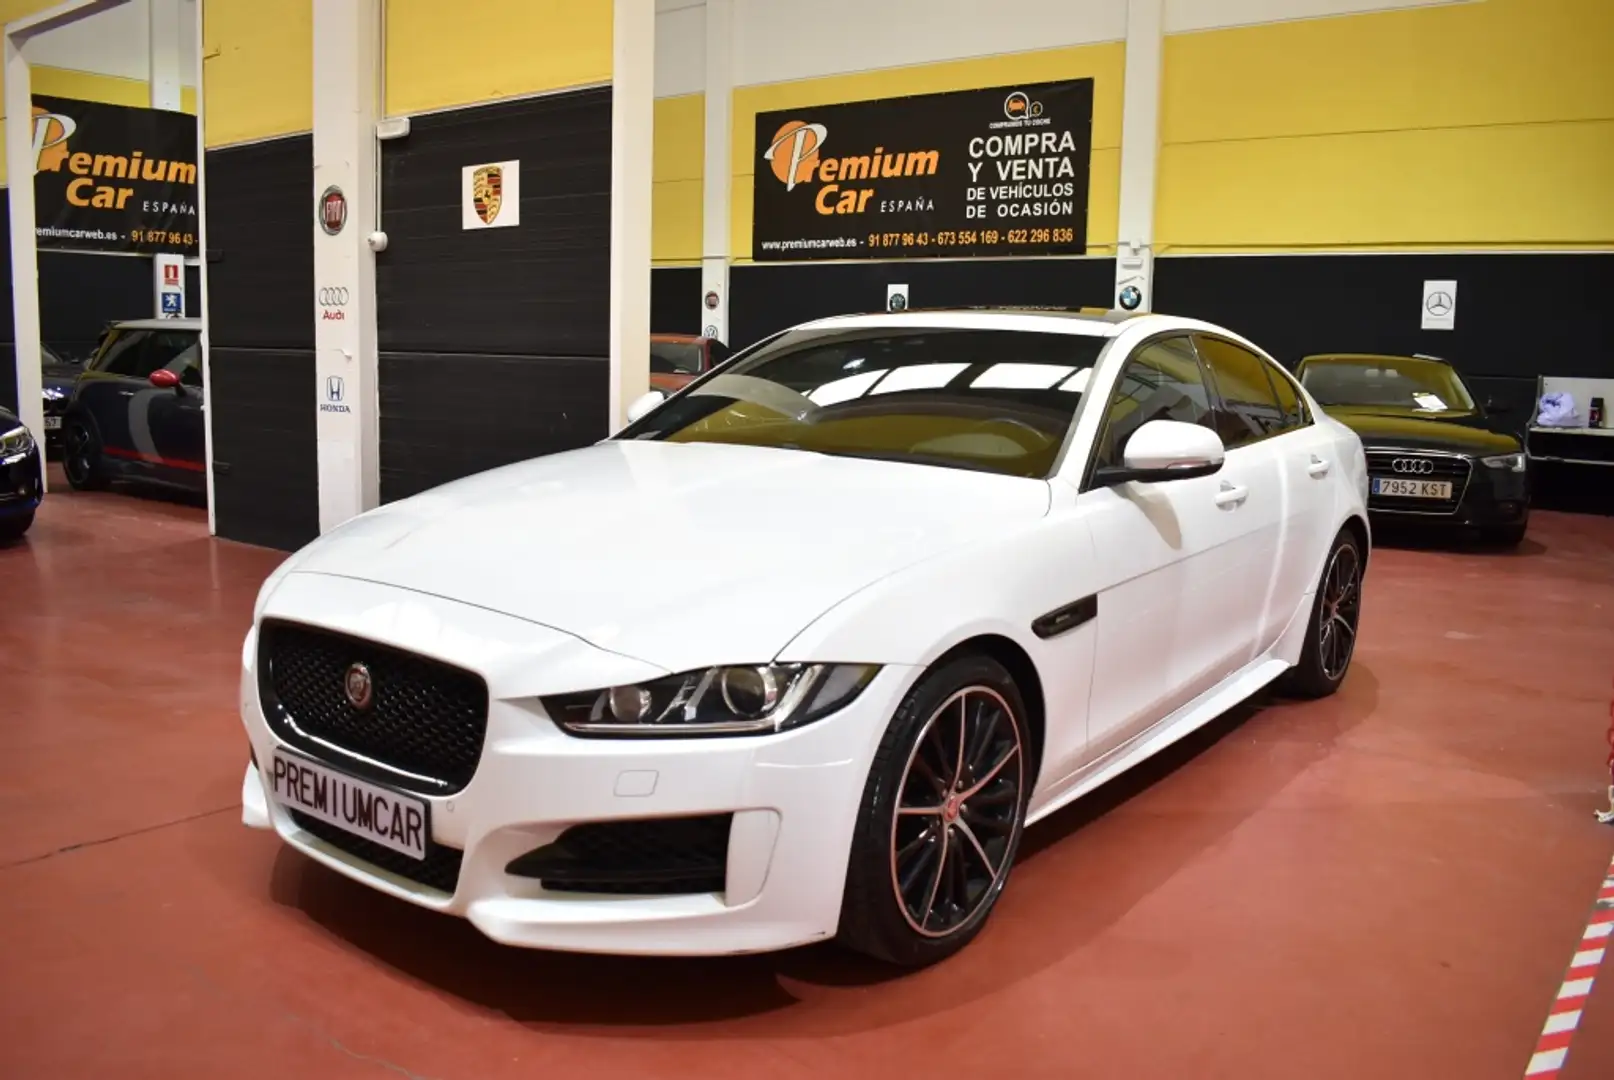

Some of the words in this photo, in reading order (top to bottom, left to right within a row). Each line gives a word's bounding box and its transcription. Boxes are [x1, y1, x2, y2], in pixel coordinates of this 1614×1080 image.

[968, 130, 1076, 158] COMPRA
[763, 123, 940, 192] Premium
[967, 162, 984, 183] Y
[996, 156, 1075, 181] VENTA
[66, 177, 134, 210] Car
[142, 201, 196, 216] ESPAÑA
[815, 184, 875, 215] Car
[880, 196, 936, 213] ESPAÑA
[966, 187, 987, 201] DE
[989, 181, 1074, 200] VEHÍCULOS
[965, 204, 987, 219] DE
[996, 198, 1074, 218] OCASIÓN
[131, 230, 144, 243] 91
[147, 231, 166, 244] 877
[168, 232, 182, 245] 96
[182, 233, 194, 245] 43
[761, 237, 858, 251] www.premiumcarweb.es
[868, 233, 880, 248] 91
[882, 233, 900, 247] 877
[901, 233, 914, 246] 96
[916, 232, 929, 246] 43
[937, 231, 956, 246] 673
[958, 230, 977, 245] 554
[980, 230, 999, 244] 169
[1007, 229, 1028, 244] 622
[1029, 228, 1050, 243] 296
[1052, 228, 1074, 242] 836
[322, 310, 345, 321] Audi
[319, 403, 351, 413] HONDA
[1381, 480, 1417, 495] 7952
[1420, 483, 1447, 497] KST
[274, 756, 422, 851] PREMIUMCAR
